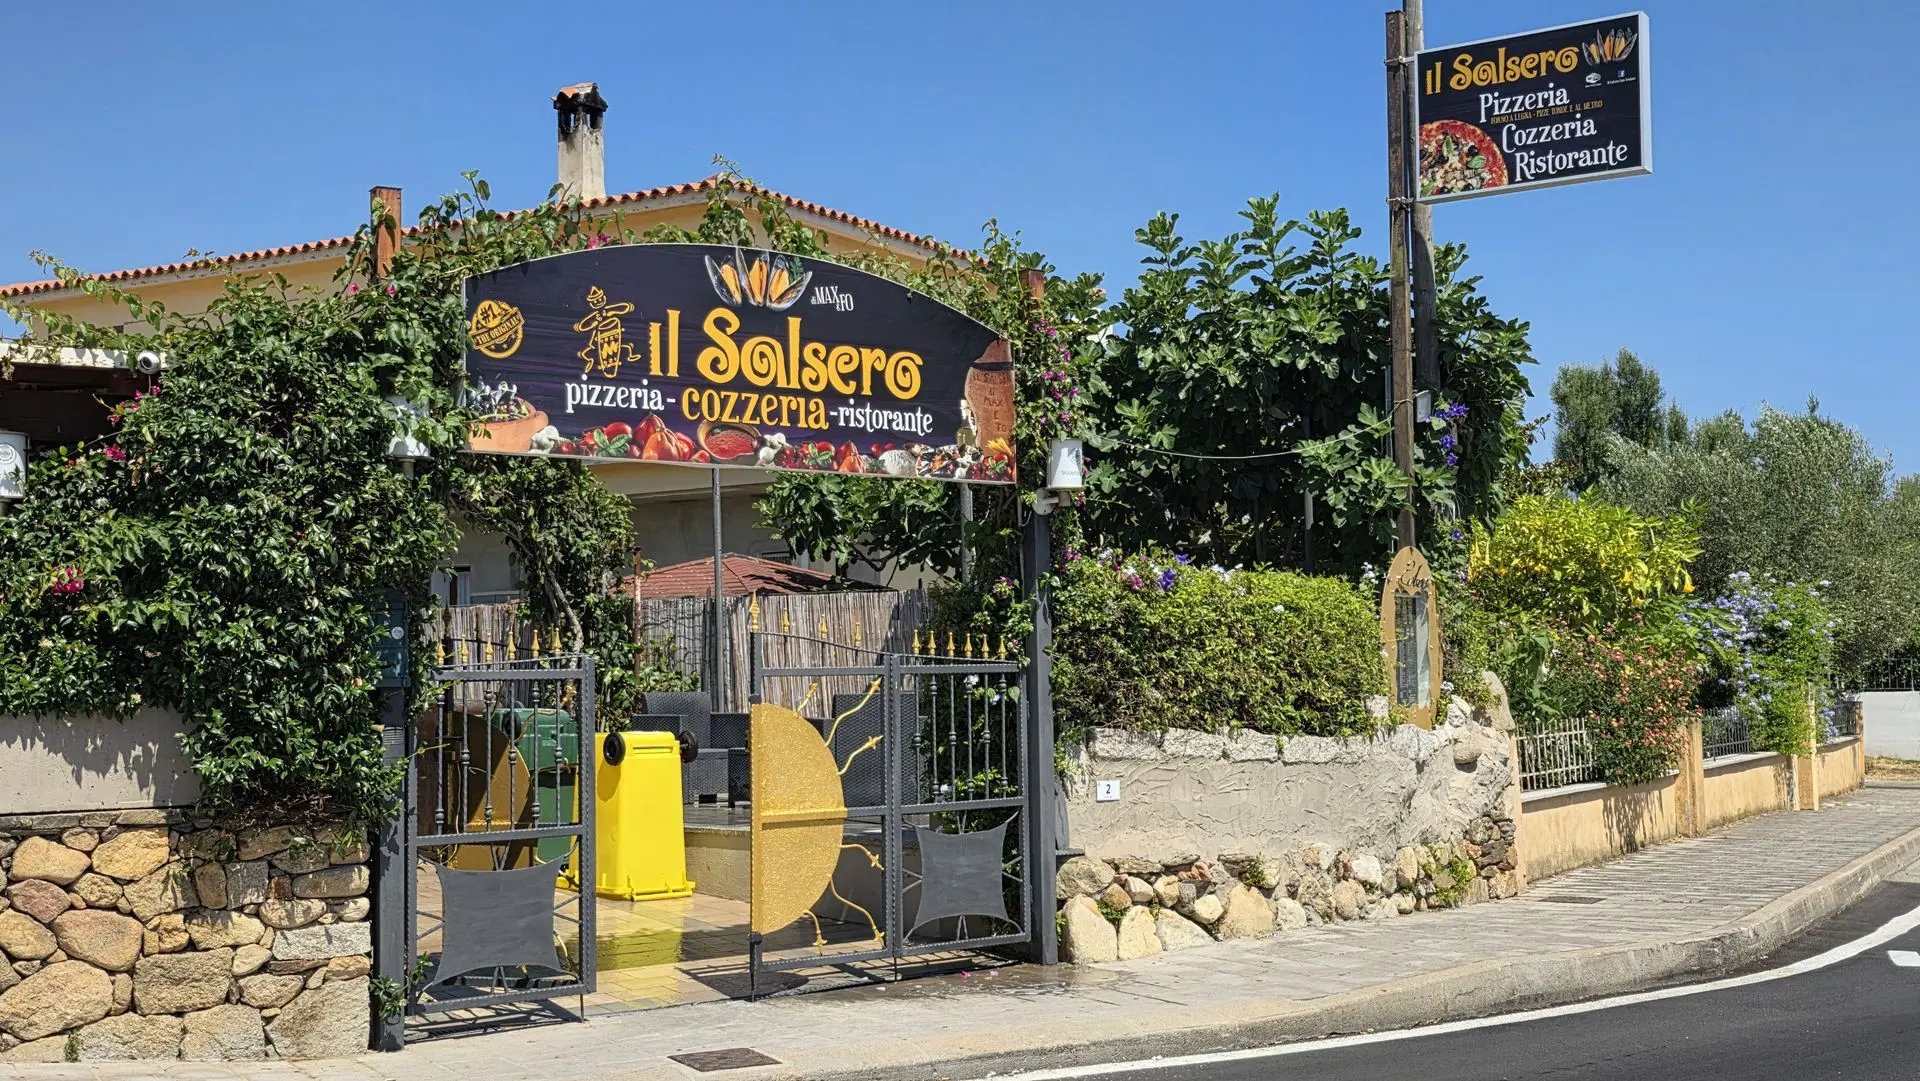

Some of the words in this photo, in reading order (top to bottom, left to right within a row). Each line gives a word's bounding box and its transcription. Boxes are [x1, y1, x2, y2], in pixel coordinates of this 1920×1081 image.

[1450, 47, 1579, 91] Salsero
[1479, 82, 1570, 124] Pizzeria
[1491, 115, 1509, 125] FORNO
[1514, 112, 1532, 121] LEGNA
[1502, 113, 1597, 154] Cozzeria
[1514, 140, 1628, 182] Ristorante
[814, 285, 840, 305] MAX
[839, 293, 854, 311] FO
[476, 332, 492, 345] THE
[489, 314, 519, 338] ORIGINAL
[479, 303, 498, 325] #1
[697, 307, 923, 400] Salsero
[1105, 783, 1111, 794] 2
